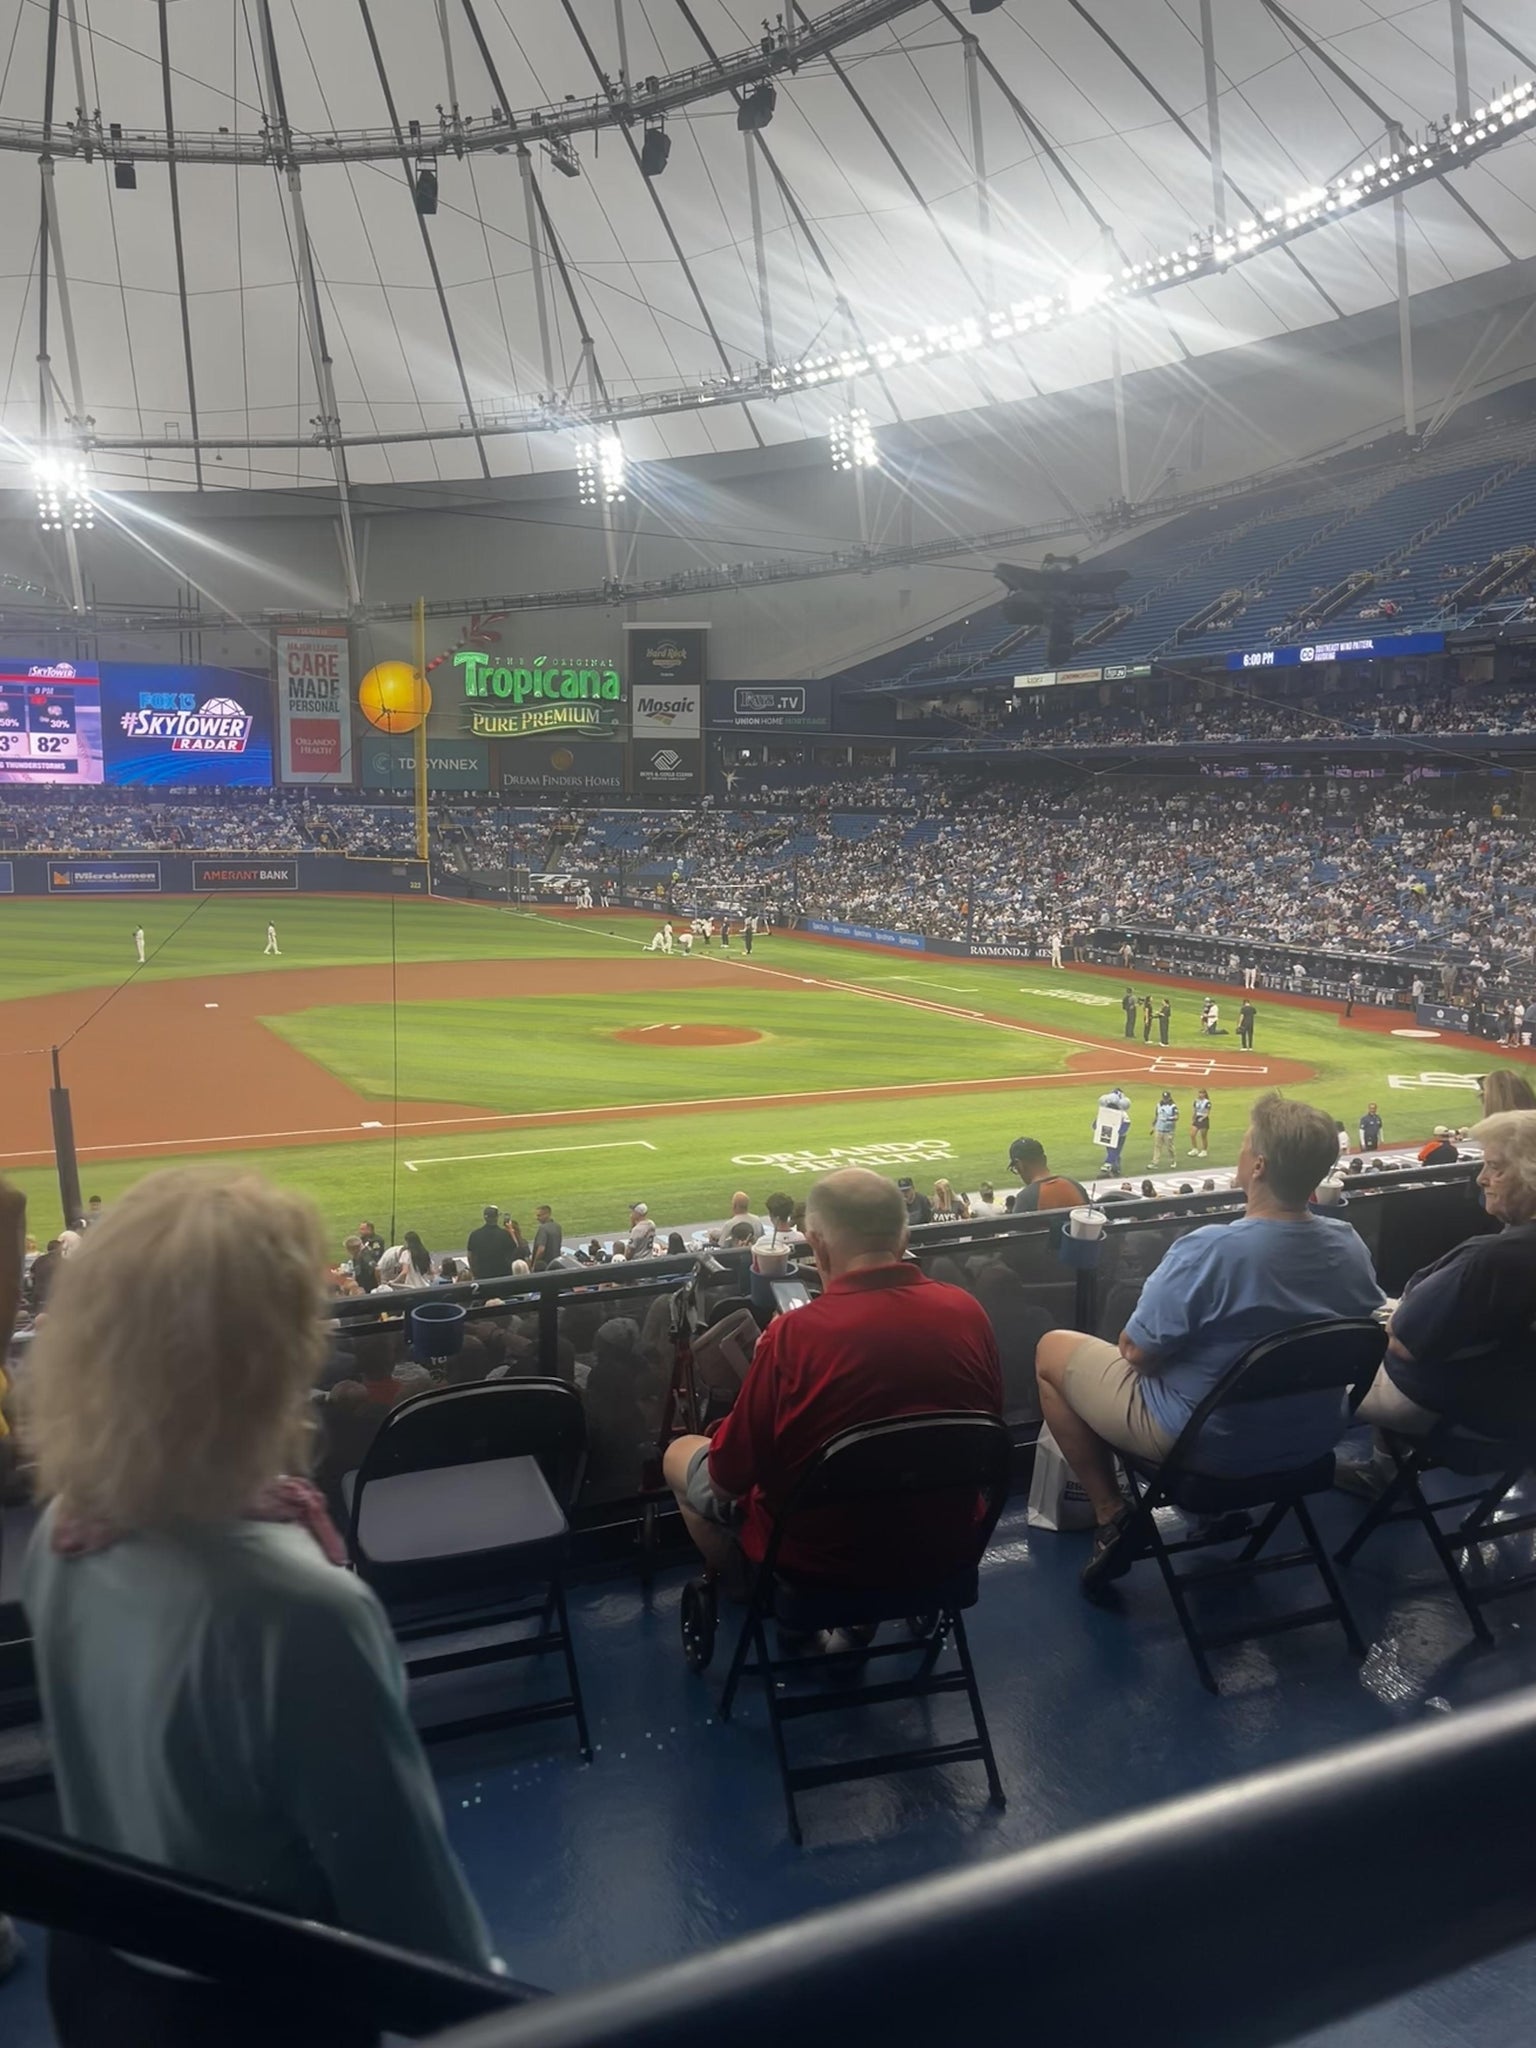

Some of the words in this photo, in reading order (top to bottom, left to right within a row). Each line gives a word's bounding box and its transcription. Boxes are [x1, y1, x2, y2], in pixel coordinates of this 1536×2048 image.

[287, 652, 340, 677] CARE
[552, 659, 614, 667] ORIGINAL
[1243, 654, 1261, 667] 6:00
[1262, 651, 1274, 665] PM
[453, 651, 622, 704] Tropicana
[42, 687, 54, 695] PM
[288, 677, 340, 699] MADE
[139, 692, 178, 710] FOX
[288, 699, 340, 713] PERSONAL
[637, 697, 695, 713] Mosaic
[50, 720, 71, 728] 30%
[473, 712, 519, 732] PURE
[521, 706, 600, 730] PREMIUM
[734, 717, 760, 725] UNION
[761, 717, 784, 725] HOME
[180, 739, 239, 750] RADAR
[294, 737, 338, 747] ORLANDO
[299, 746, 334, 756] HEALTH
[398, 757, 416, 769] TD
[503, 773, 540, 785] DREAM
[542, 773, 583, 786] FINDERS
[584, 774, 621, 787] HOMES
[74, 871, 156, 880] MicroLumen
[203, 870, 259, 880] AMERANT
[259, 869, 289, 880] BANK
[970, 945, 1021, 957] RAYMOND
[731, 1139, 952, 1166] ORLANDO
[770, 1149, 960, 1174] HEALTH
